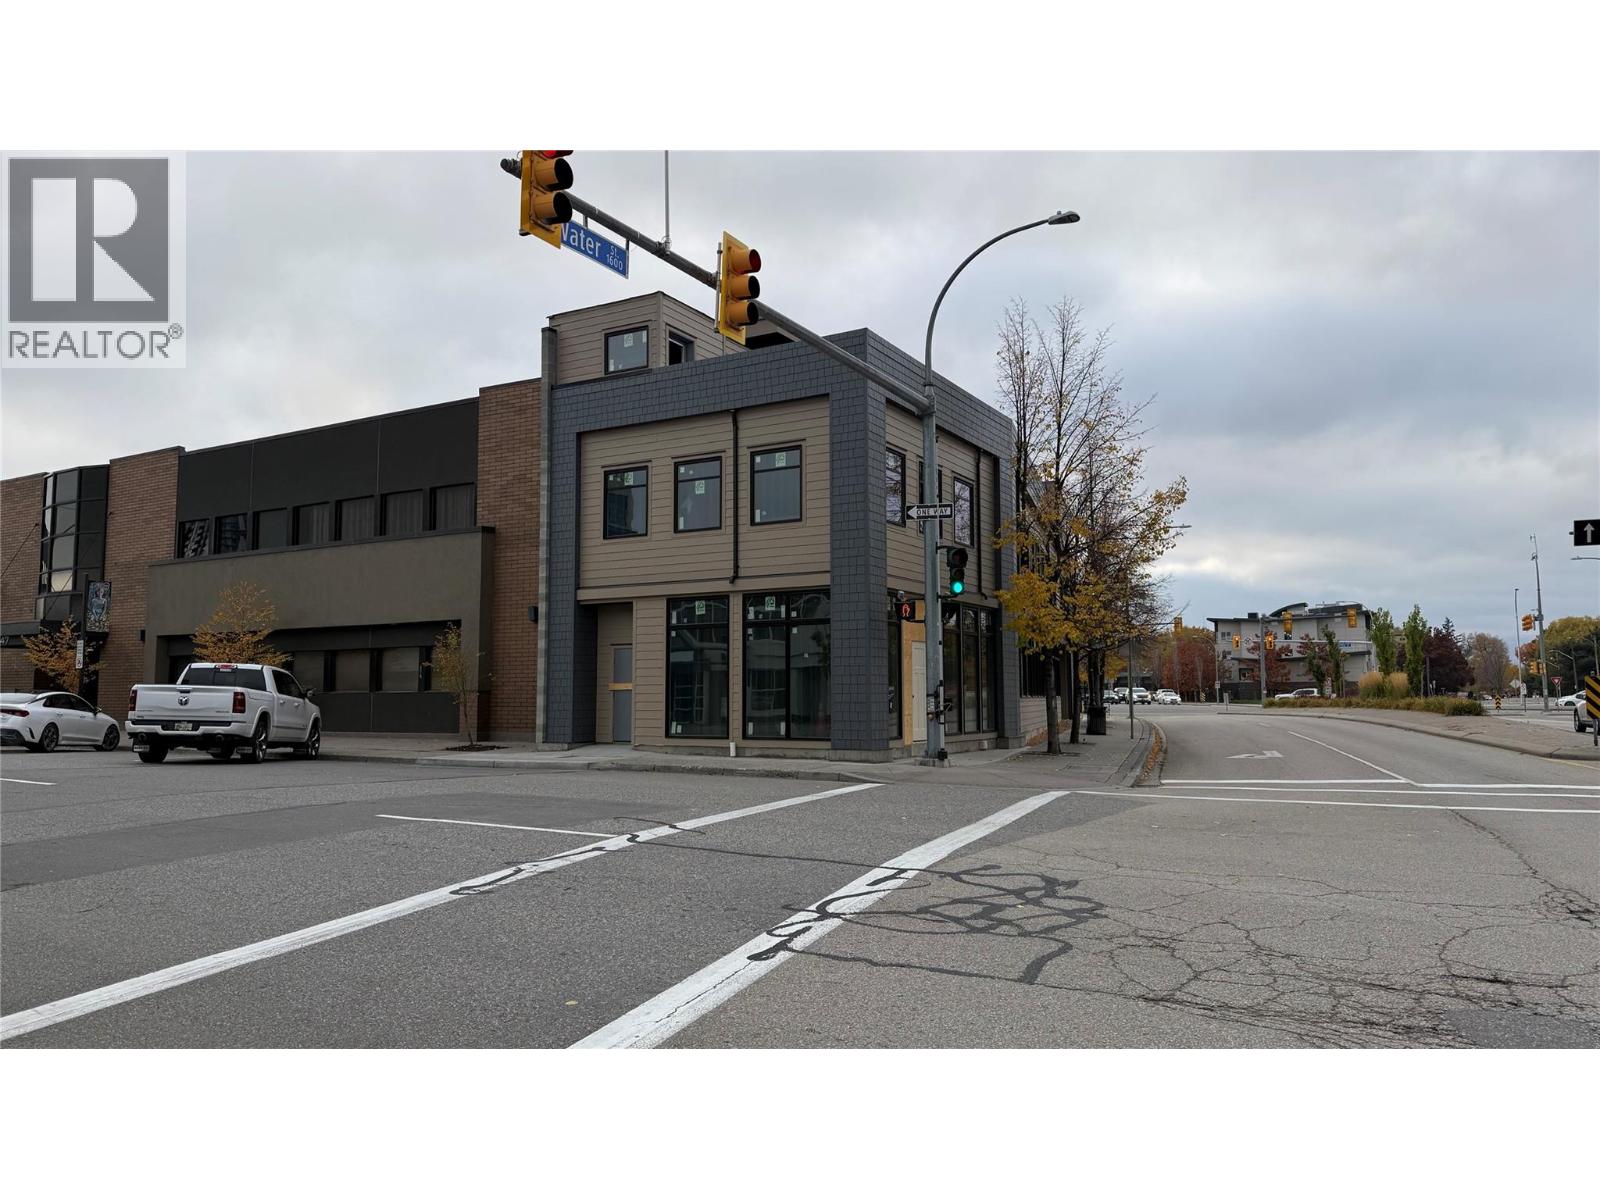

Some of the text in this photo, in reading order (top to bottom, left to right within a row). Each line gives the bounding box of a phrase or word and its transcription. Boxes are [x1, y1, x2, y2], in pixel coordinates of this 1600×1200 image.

[606, 253, 623, 271] 1600
[916, 507, 948, 516] ONE WAY
